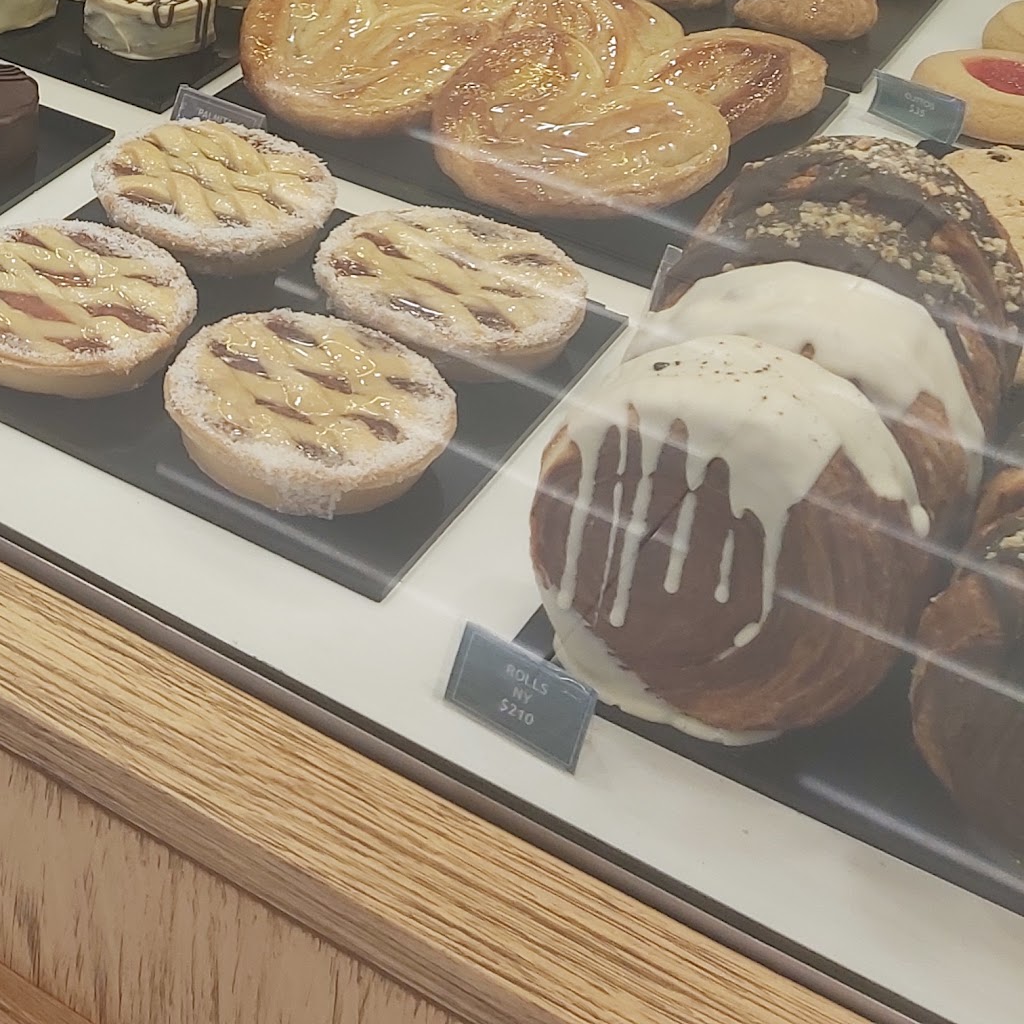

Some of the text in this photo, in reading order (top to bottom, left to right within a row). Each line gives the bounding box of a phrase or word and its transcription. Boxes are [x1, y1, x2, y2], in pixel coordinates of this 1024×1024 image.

[197, 108, 232, 124] PALMIT
[506, 663, 549, 696] ROLLS
[512, 686, 533, 704] NY
[500, 698, 535, 726] $210
